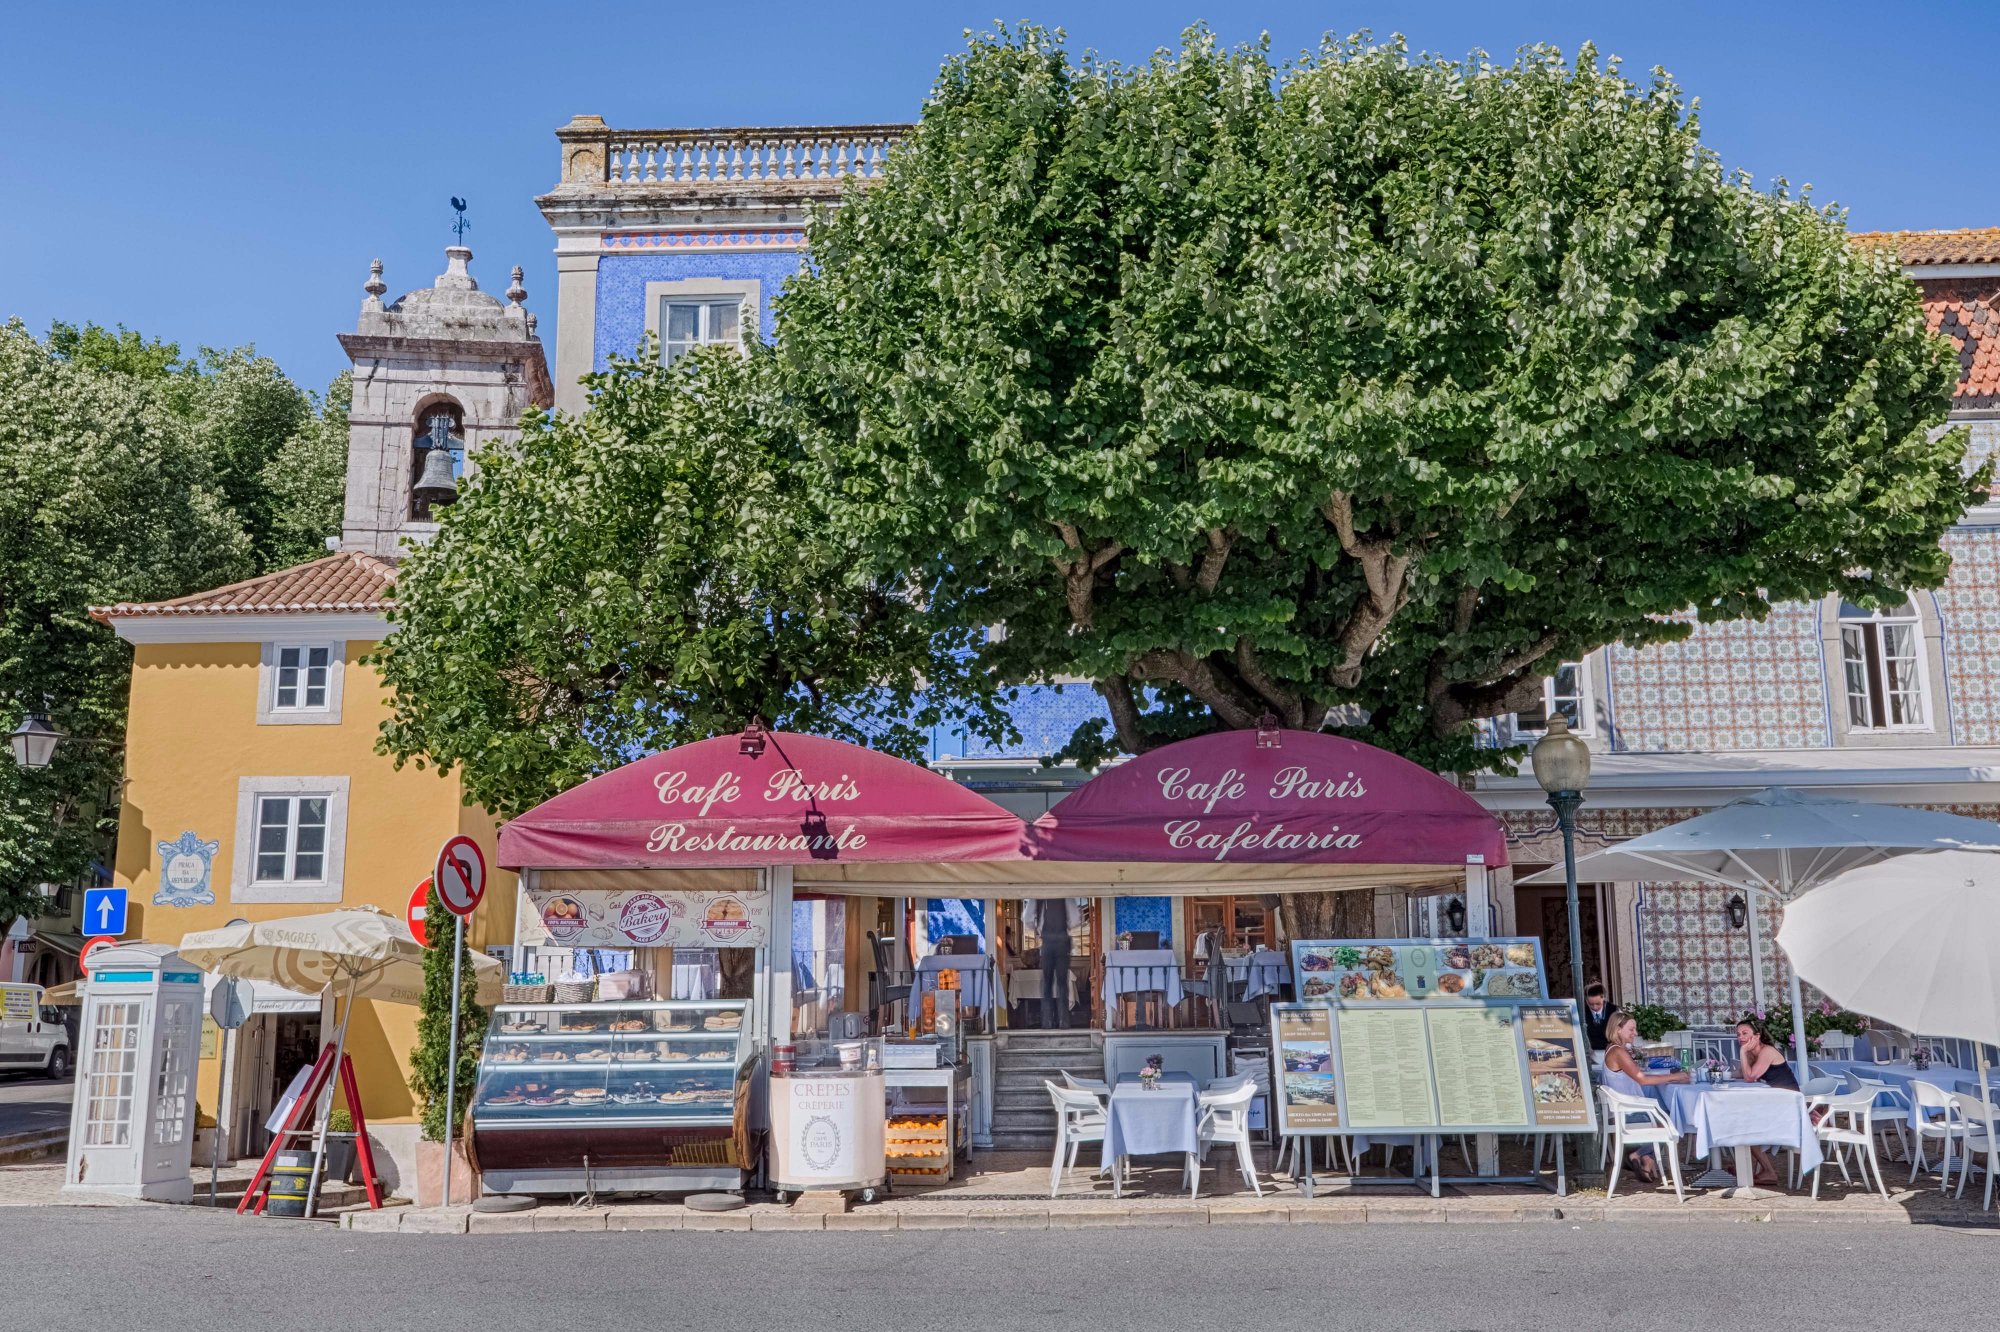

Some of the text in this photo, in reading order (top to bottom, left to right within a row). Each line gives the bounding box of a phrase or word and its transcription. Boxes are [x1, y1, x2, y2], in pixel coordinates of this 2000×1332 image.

[653, 769, 861, 817] Café Paris
[1157, 766, 1367, 814] Café Paris
[646, 823, 868, 852] Restaurante
[1163, 820, 1363, 861] Cafetaria
[275, 929, 317, 944] SAGRES
[621, 912, 668, 929] Bakery
